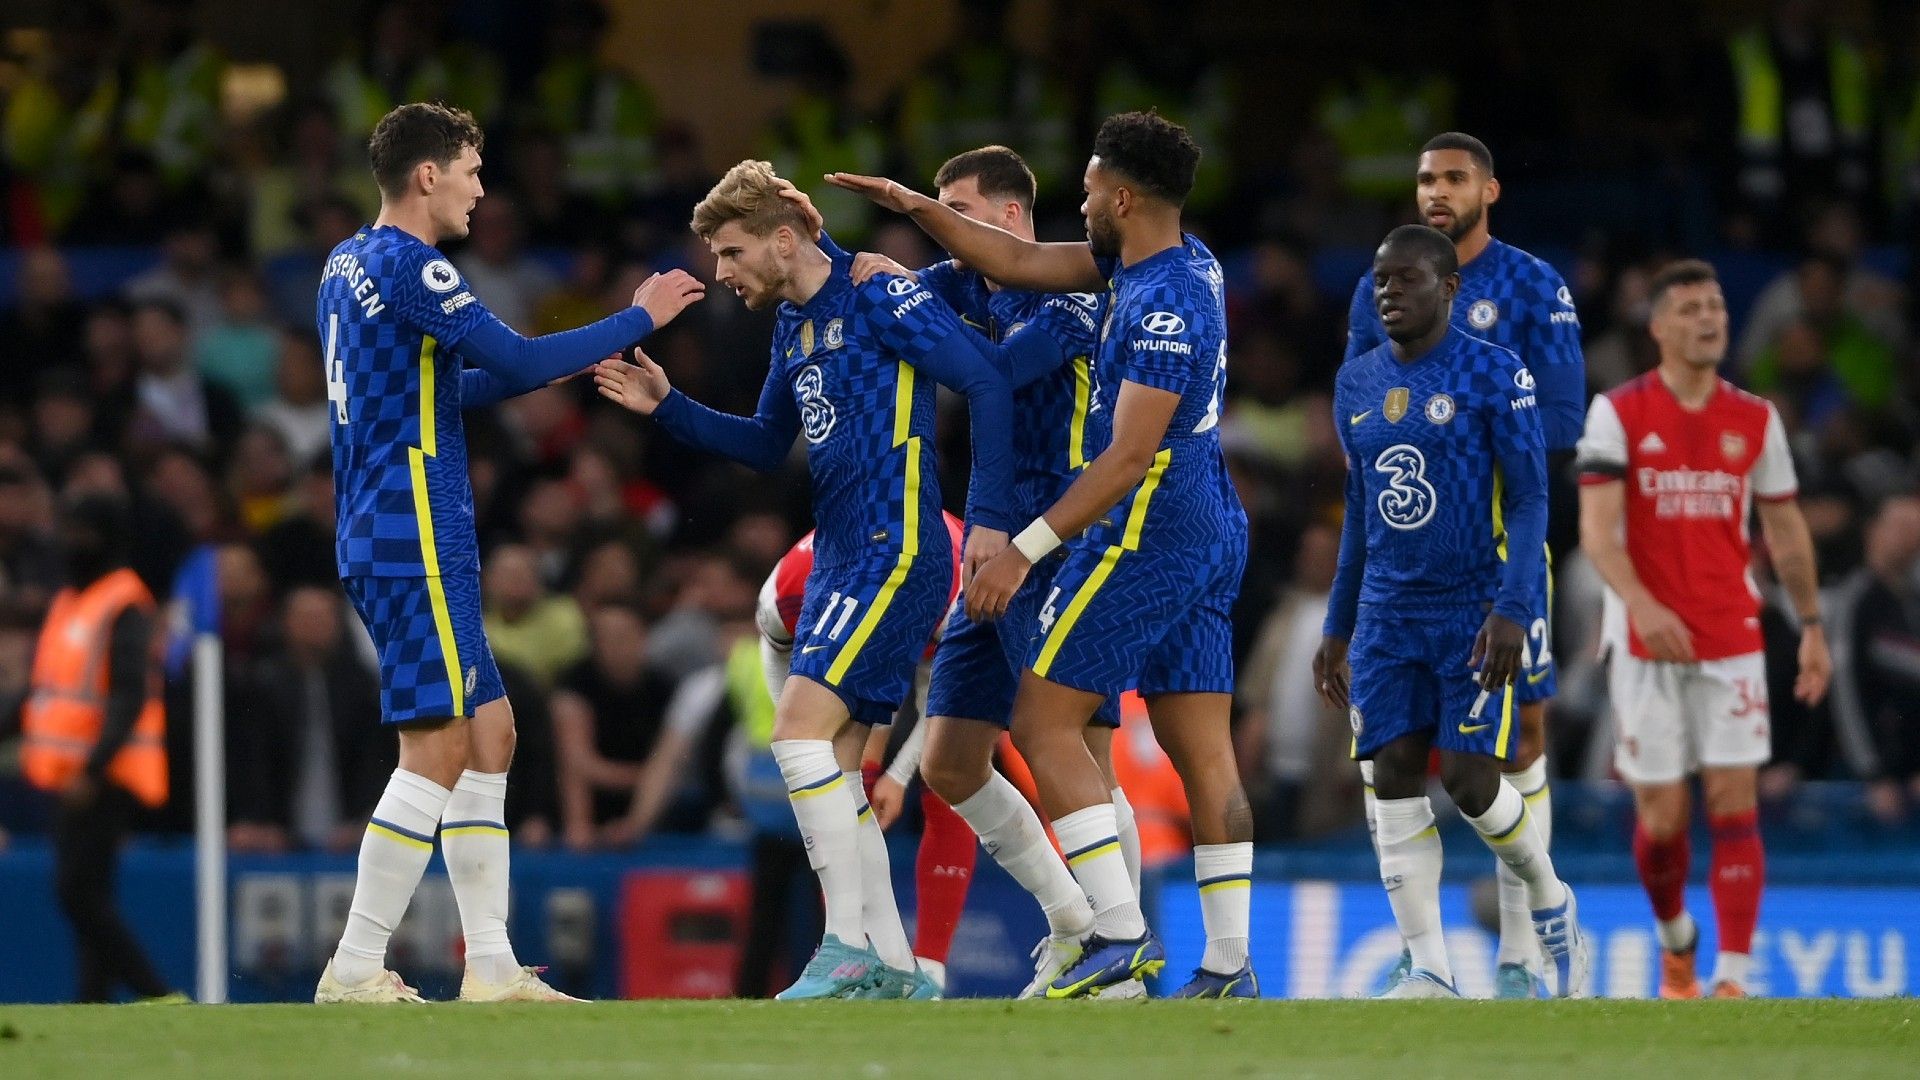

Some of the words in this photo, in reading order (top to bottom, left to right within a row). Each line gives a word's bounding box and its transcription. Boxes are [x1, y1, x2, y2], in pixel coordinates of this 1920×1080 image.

[1044, 298, 1096, 332] HYUNDAI
[326, 313, 350, 425] 4
[1132, 339, 1192, 355] HYUNDAI
[812, 591, 859, 640] 11
[1037, 585, 1062, 635] 4
